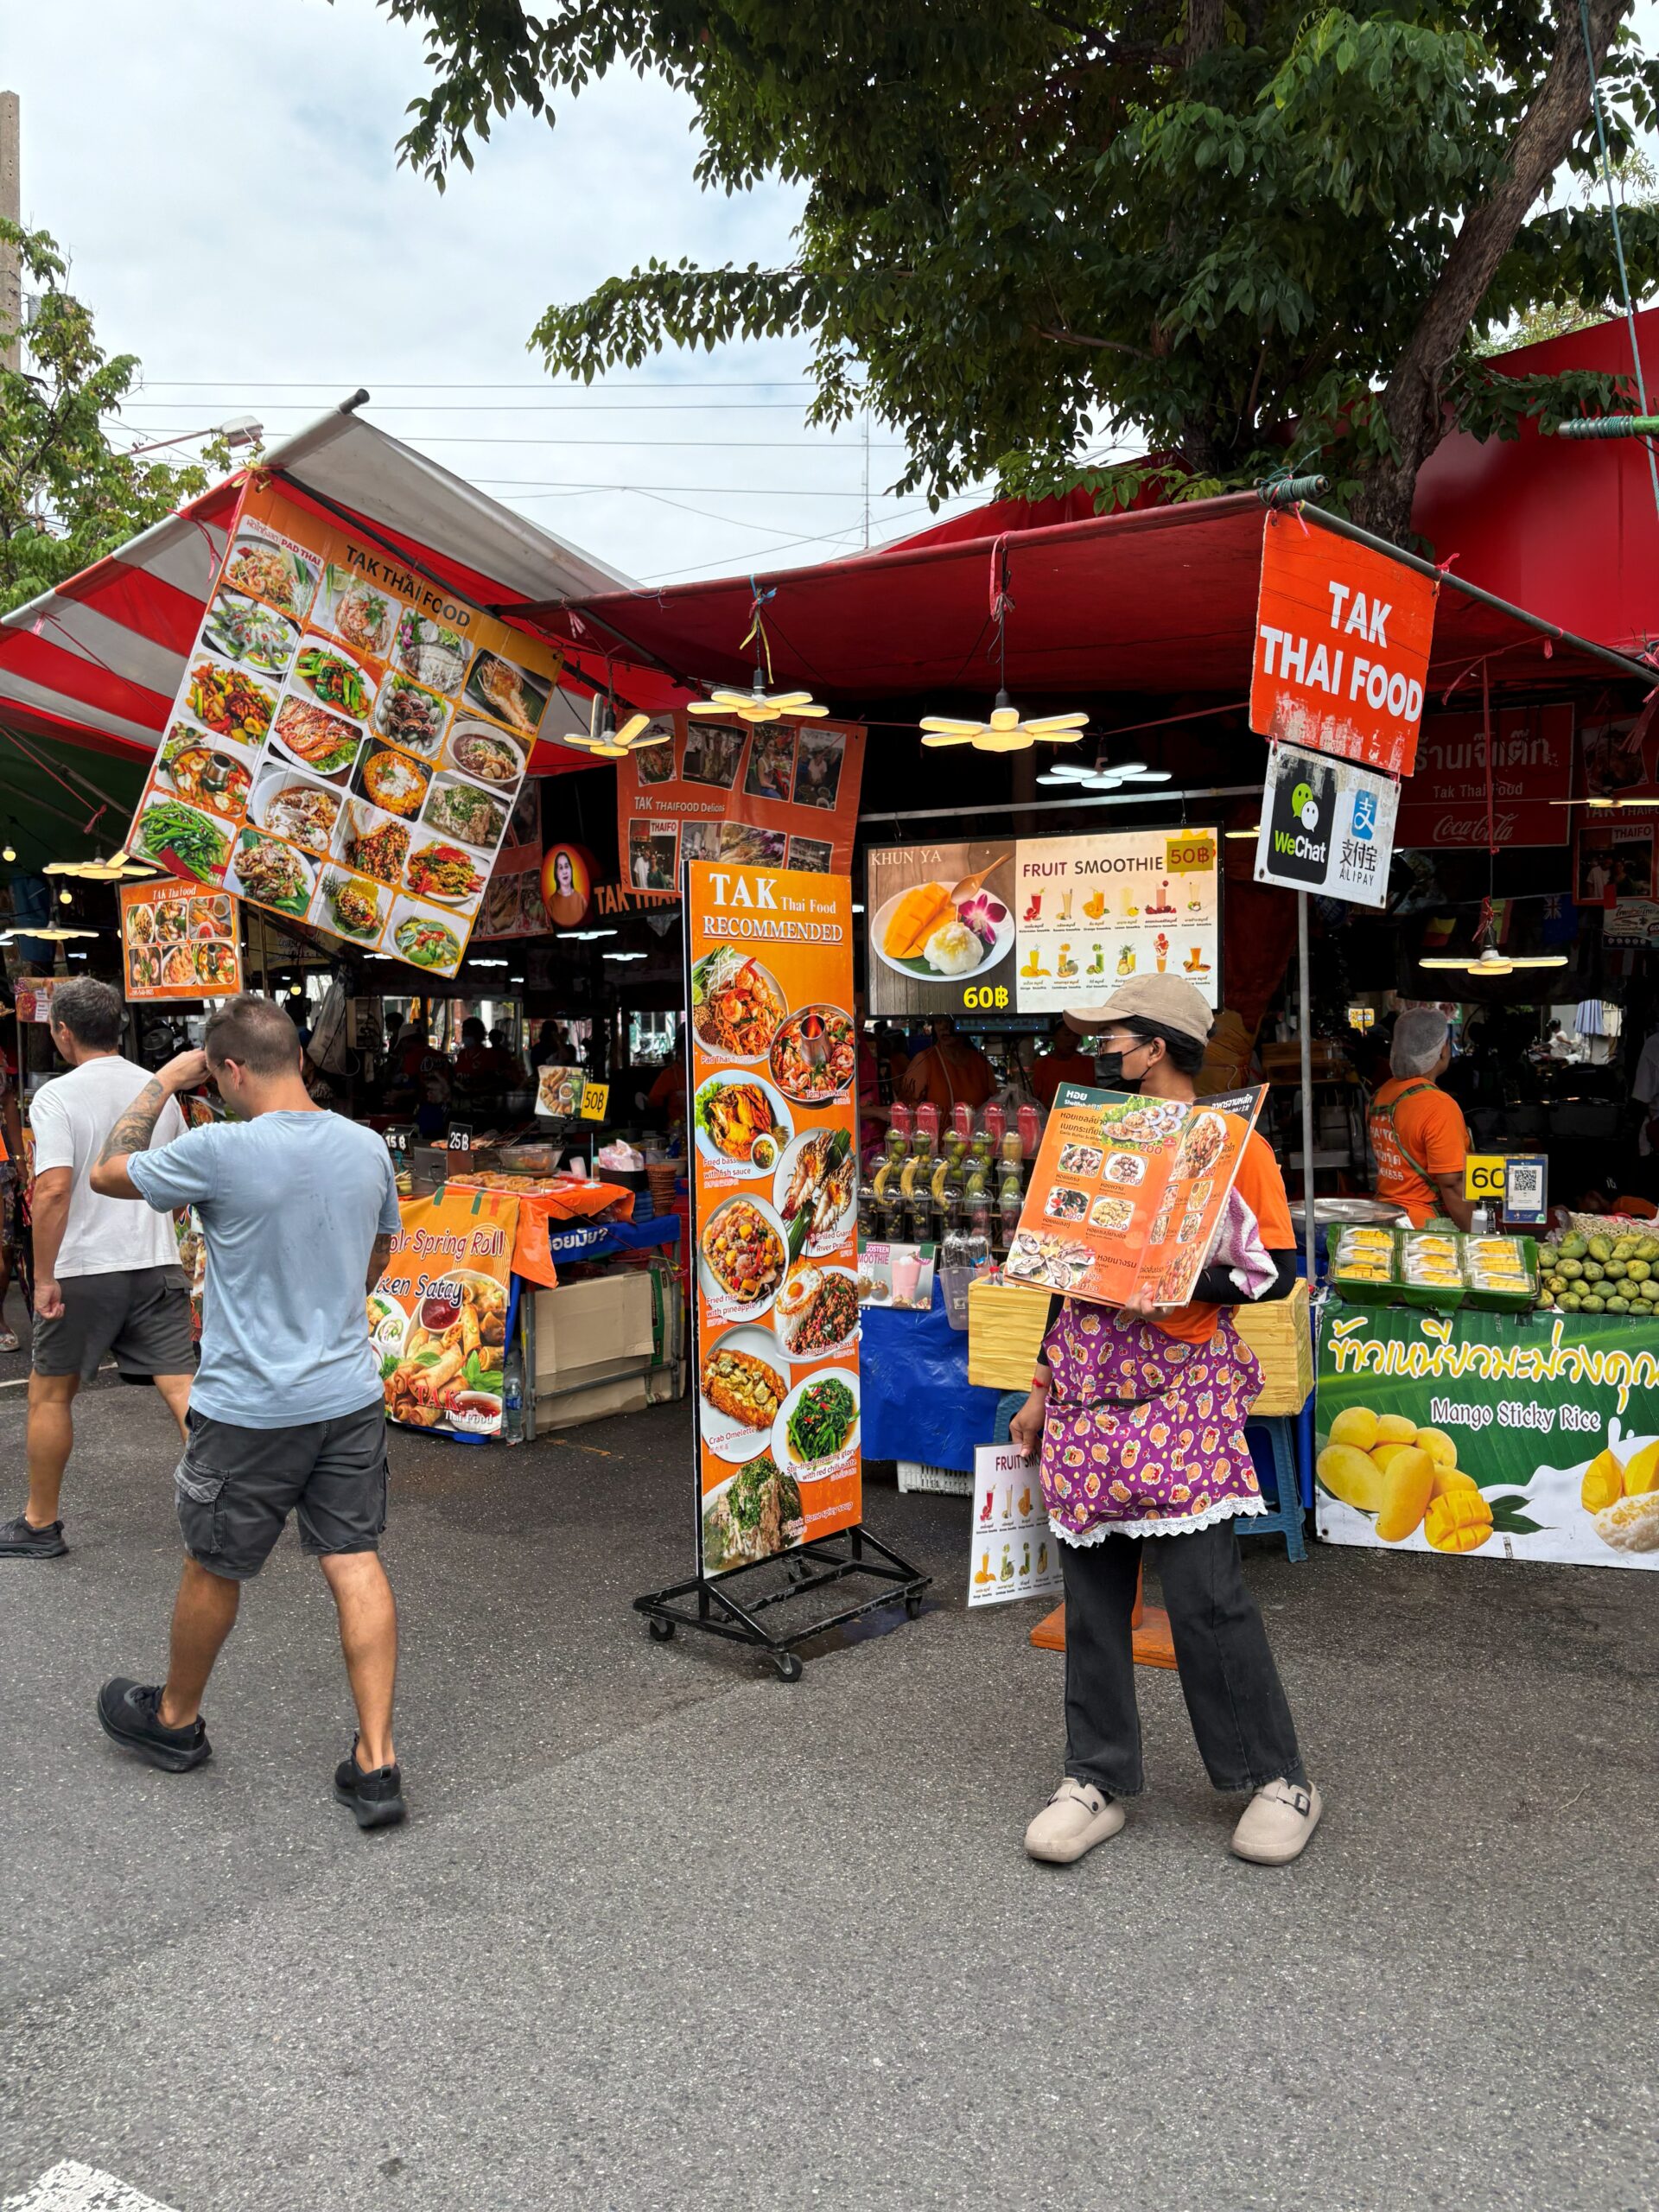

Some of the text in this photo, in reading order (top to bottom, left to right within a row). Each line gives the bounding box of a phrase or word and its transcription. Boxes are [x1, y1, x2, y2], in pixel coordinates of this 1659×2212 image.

[281, 538, 321, 566] PAD THAI
[346, 544, 471, 628] TAK THAI FOOD
[1329, 581, 1392, 648] TAK
[1260, 625, 1423, 722] THAI FOOD
[1433, 782, 1523, 798] Tak Thai ood
[634, 796, 653, 811] TAK
[655, 801, 699, 812] THAIFOOD
[1614, 826, 1651, 839] THAIFO
[1274, 830, 1326, 863] WeChat
[1339, 839, 1377, 872] 支付宝
[871, 850, 943, 866] KHUN YA
[1023, 856, 1164, 878] FRUIT SMOOTHIE
[1339, 870, 1375, 887] ALIPAY
[594, 883, 630, 915] TAK
[709, 872, 836, 914] TAK Thai Food
[702, 915, 843, 942] RECOMMENDED
[702, 1056, 715, 1065] Pad
[1066, 1090, 1088, 1101] หอย
[385, 1135, 397, 1148] 15
[1141, 1143, 1162, 1155] 200
[1471, 1167, 1505, 1189] 60
[412, 1229, 467, 1260] Spring
[470, 1230, 505, 1256] Roll
[817, 1243, 832, 1252] River
[415, 1274, 464, 1308] Satay
[706, 1295, 723, 1304] Fried
[707, 1302, 756, 1317] with pineapple
[415, 1385, 461, 1412] TAK
[444, 1409, 493, 1425] Thai Food
[1432, 1399, 1600, 1433] Mango Sticky Rice
[709, 1427, 756, 1444] Crab Omelette
[787, 1449, 855, 1474] Stir-fried morning glory
[841, 1460, 856, 1471] paste
[995, 1455, 1020, 1471] FRUIT
